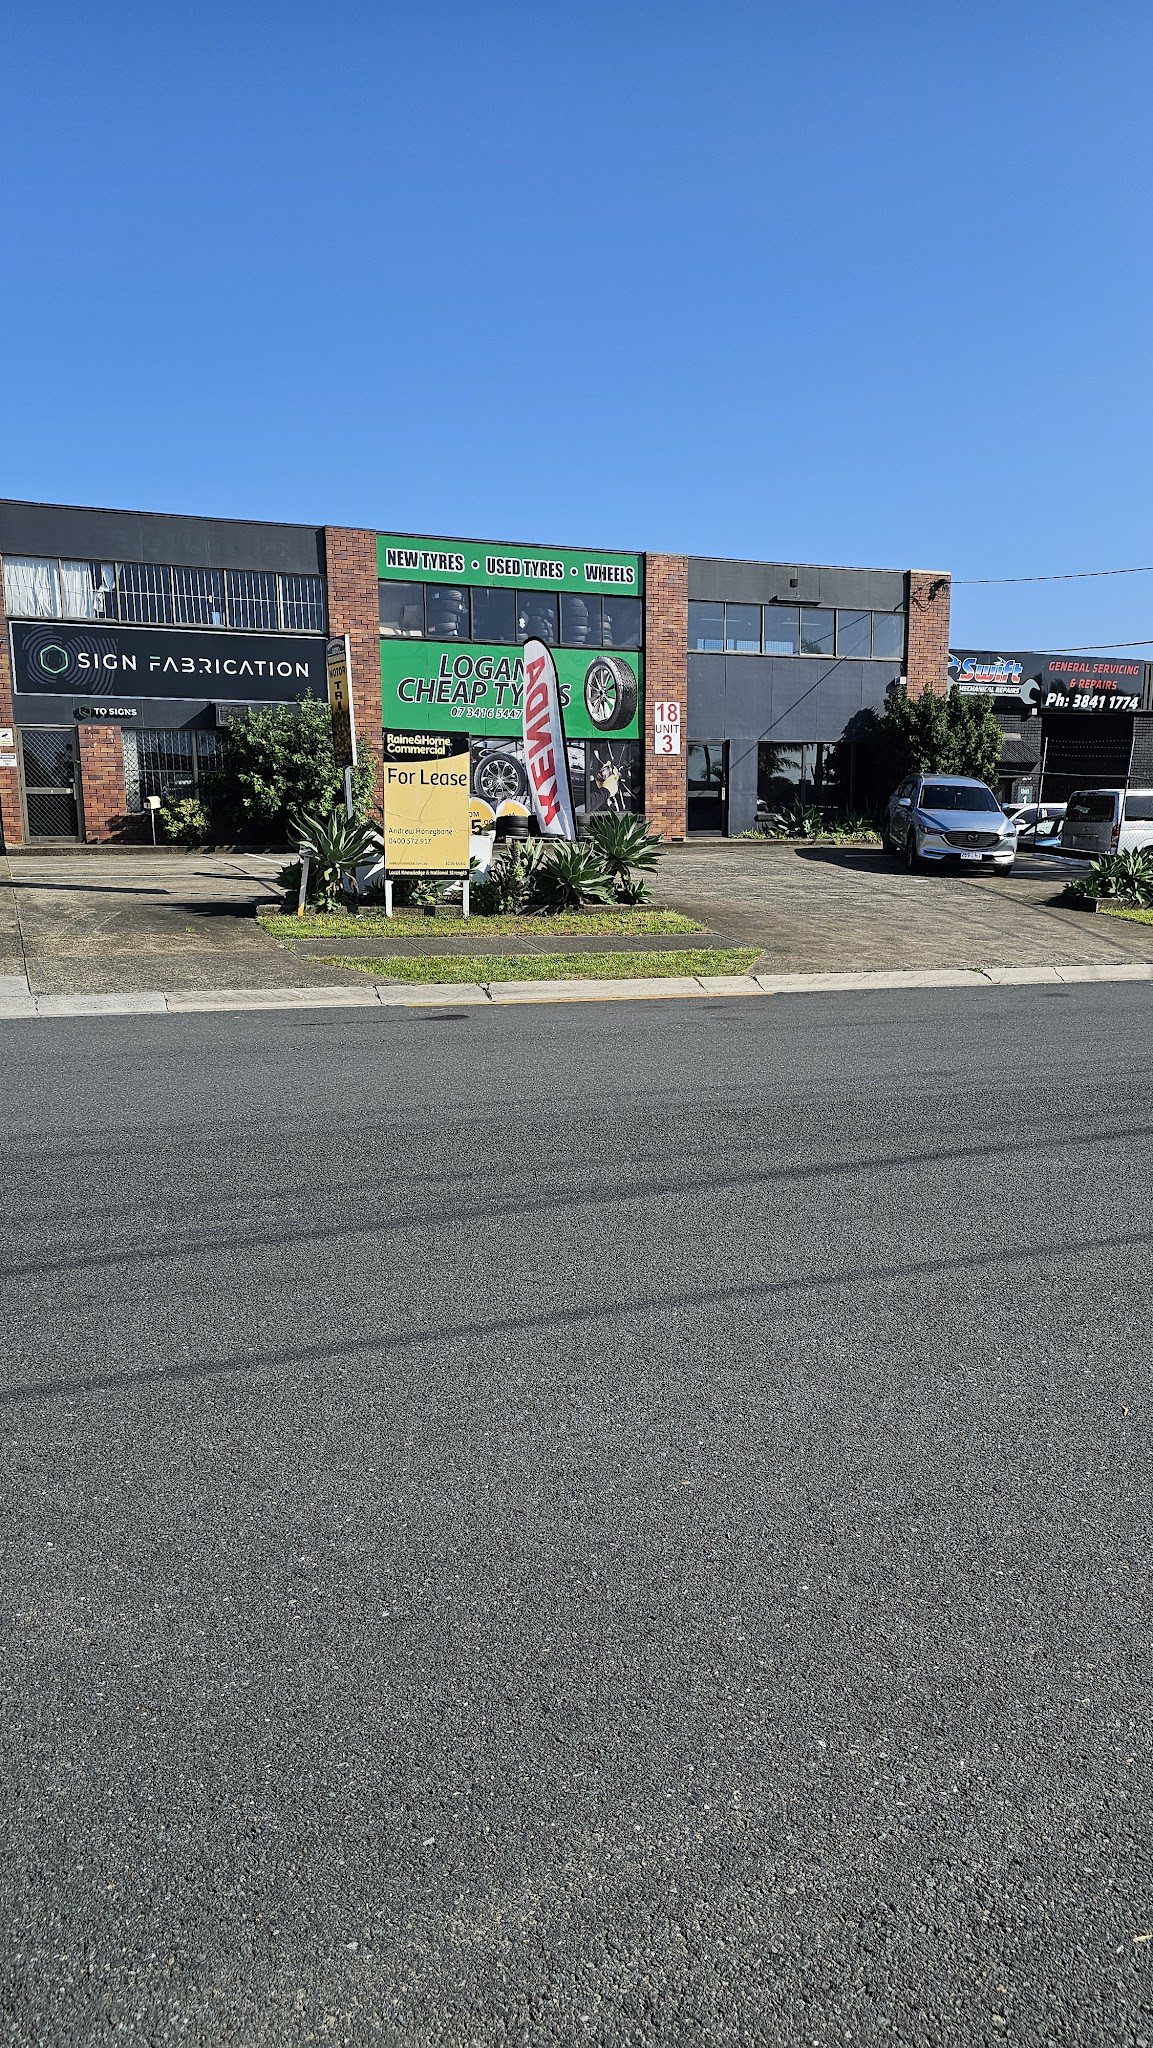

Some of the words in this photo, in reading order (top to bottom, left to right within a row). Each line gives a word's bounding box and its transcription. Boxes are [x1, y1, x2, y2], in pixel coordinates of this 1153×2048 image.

[387, 549, 419, 567] NEW
[421, 552, 464, 571] TYRES
[487, 557, 521, 574] USED
[523, 560, 563, 578] TYRES
[585, 564, 634, 582] WHEELS
[77, 652, 137, 671] SIGN
[150, 655, 310, 677] FABRICATION
[439, 654, 524, 681] LOGAN
[957, 656, 1023, 683] Swift
[1048, 661, 1090, 673] GENERAL
[1092, 663, 1139, 675] SERVICING
[959, 685, 995, 693] MECHANICAL
[1069, 678, 1076, 688] &
[1078, 679, 1118, 690] REPAIRS
[397, 678, 487, 704] CHEAP
[493, 682, 571, 708] TYS
[1045, 692, 1070, 707] Ph:
[1072, 694, 1106, 708] 3841
[1109, 695, 1139, 709] 1774
[94, 707, 107, 716] TQ
[109, 707, 138, 716] SIGNS
[451, 707, 464, 717] 07
[467, 708, 494, 718] 3416
[496, 708, 523, 719] 5447
[656, 703, 678, 722] 18
[655, 724, 680, 734] UNIT
[387, 744, 446, 755] Commercial
[662, 734, 673, 753] 3
[388, 768, 416, 785] For
[420, 769, 468, 787] Lease
[388, 827, 415, 835] Andrew
